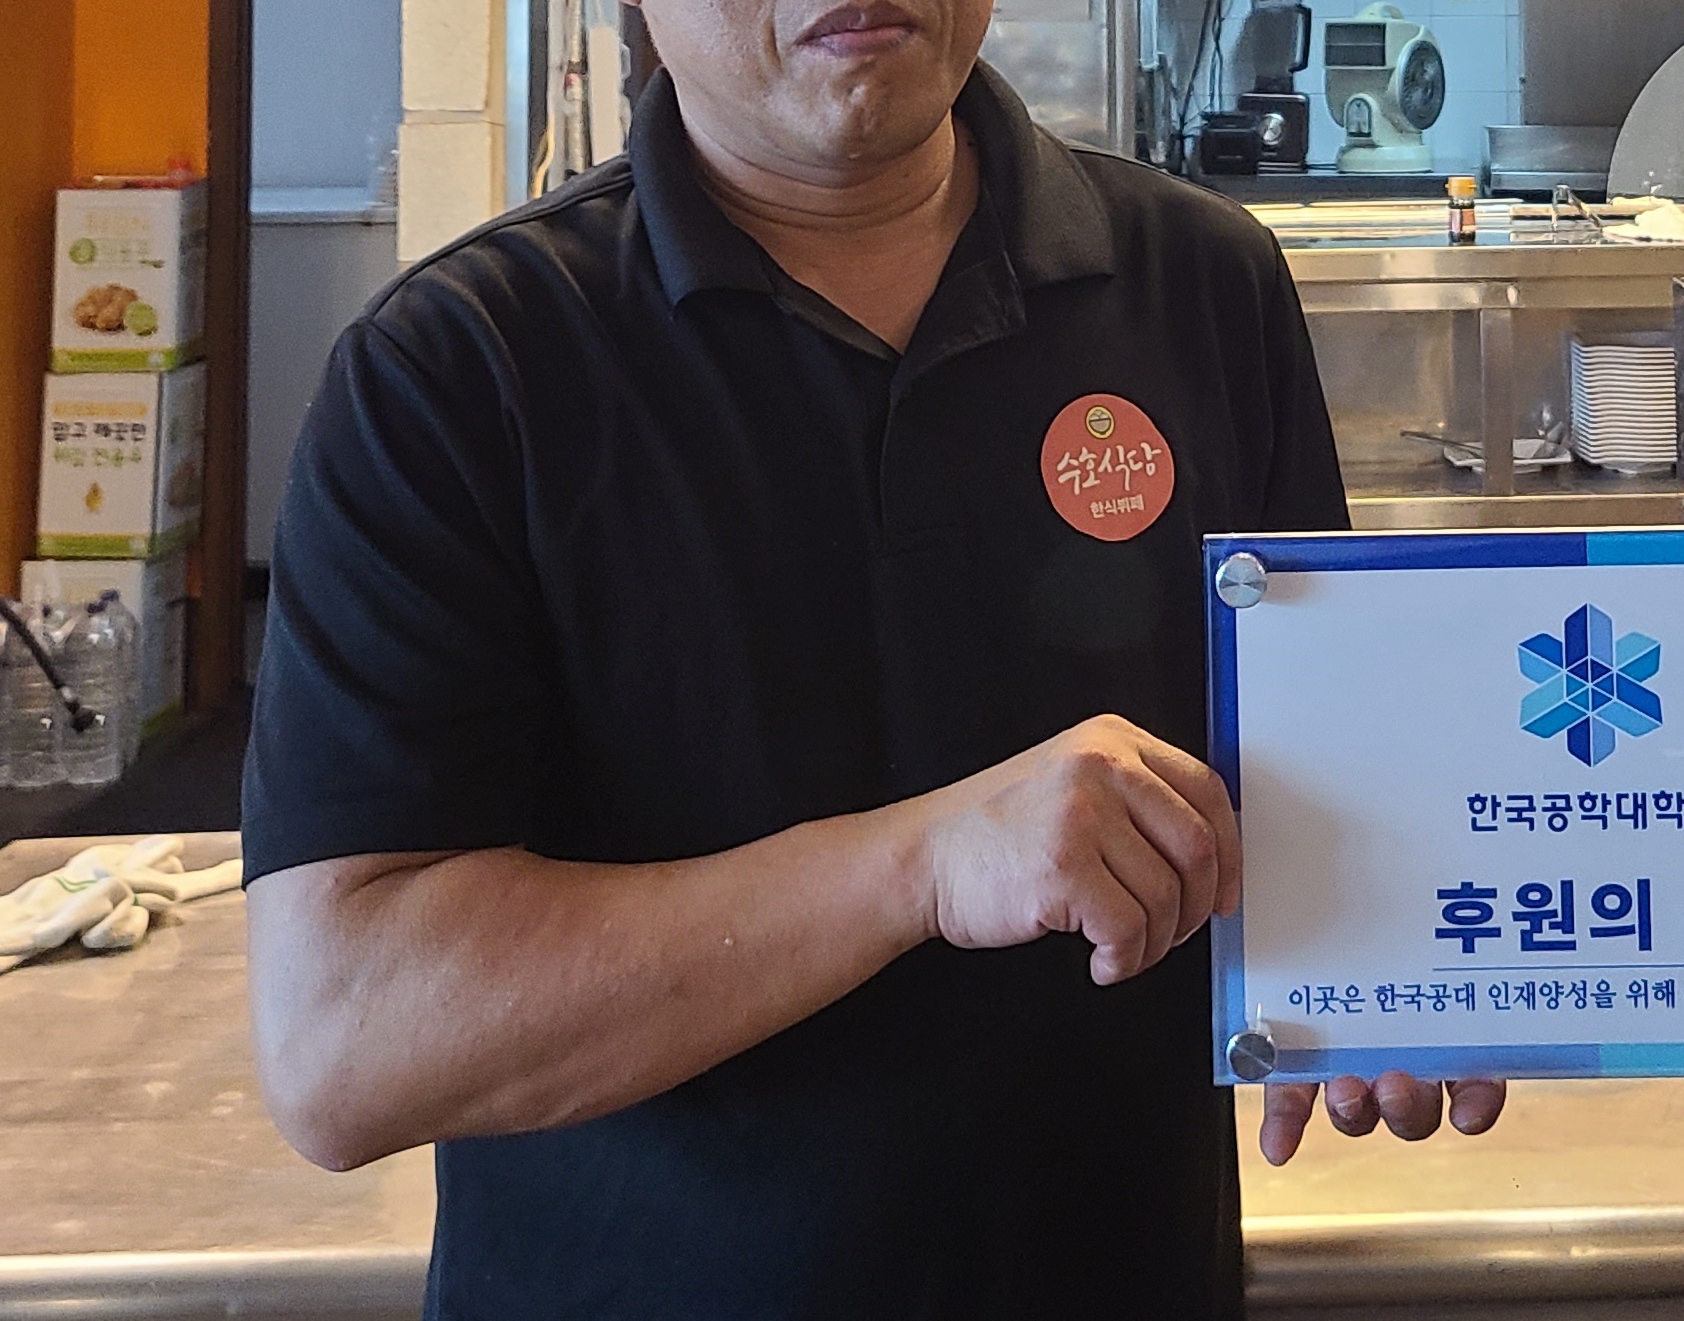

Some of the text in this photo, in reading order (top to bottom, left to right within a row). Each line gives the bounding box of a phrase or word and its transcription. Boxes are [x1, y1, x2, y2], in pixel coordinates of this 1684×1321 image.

[1056, 441, 1162, 496] 수호식당
[1089, 494, 1145, 519] 한식뷔페
[1433, 876, 1654, 955] 후원의
[1287, 983, 1367, 1016] 이곳은
[1372, 980, 1477, 1014] 한국공대
[1487, 978, 1618, 1012] 인재양성을
[1624, 977, 1676, 1011] 위해
